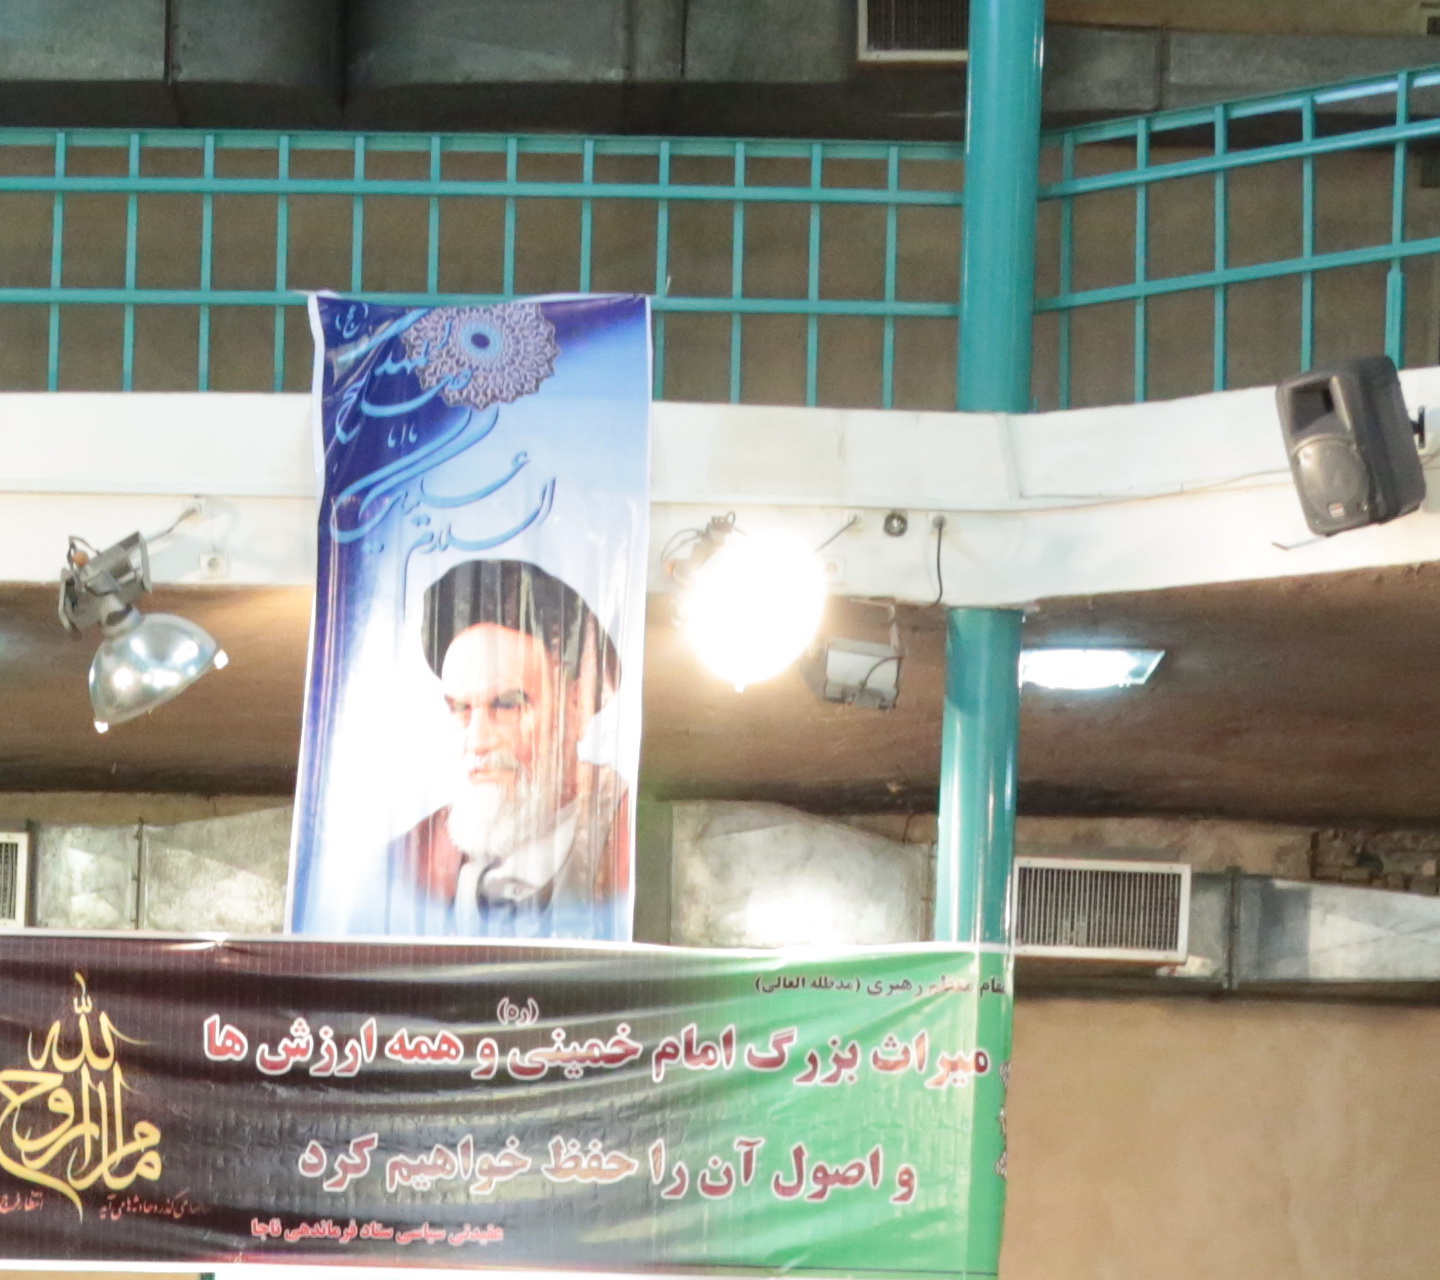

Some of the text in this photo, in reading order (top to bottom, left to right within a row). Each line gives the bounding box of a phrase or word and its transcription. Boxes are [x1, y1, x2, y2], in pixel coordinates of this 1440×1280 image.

[203, 1013, 990, 1089] میراث بزرگ امام خمینی و همه ارزش ها
[298, 1131, 917, 1205] و اصول آن را حفظ خواهیم کرد
[250, 1217, 282, 1241] ناجا
[283, 1217, 358, 1244] فرماندهی
[359, 1219, 394, 1241] ستاد
[395, 1220, 447, 1246] سیاسی
